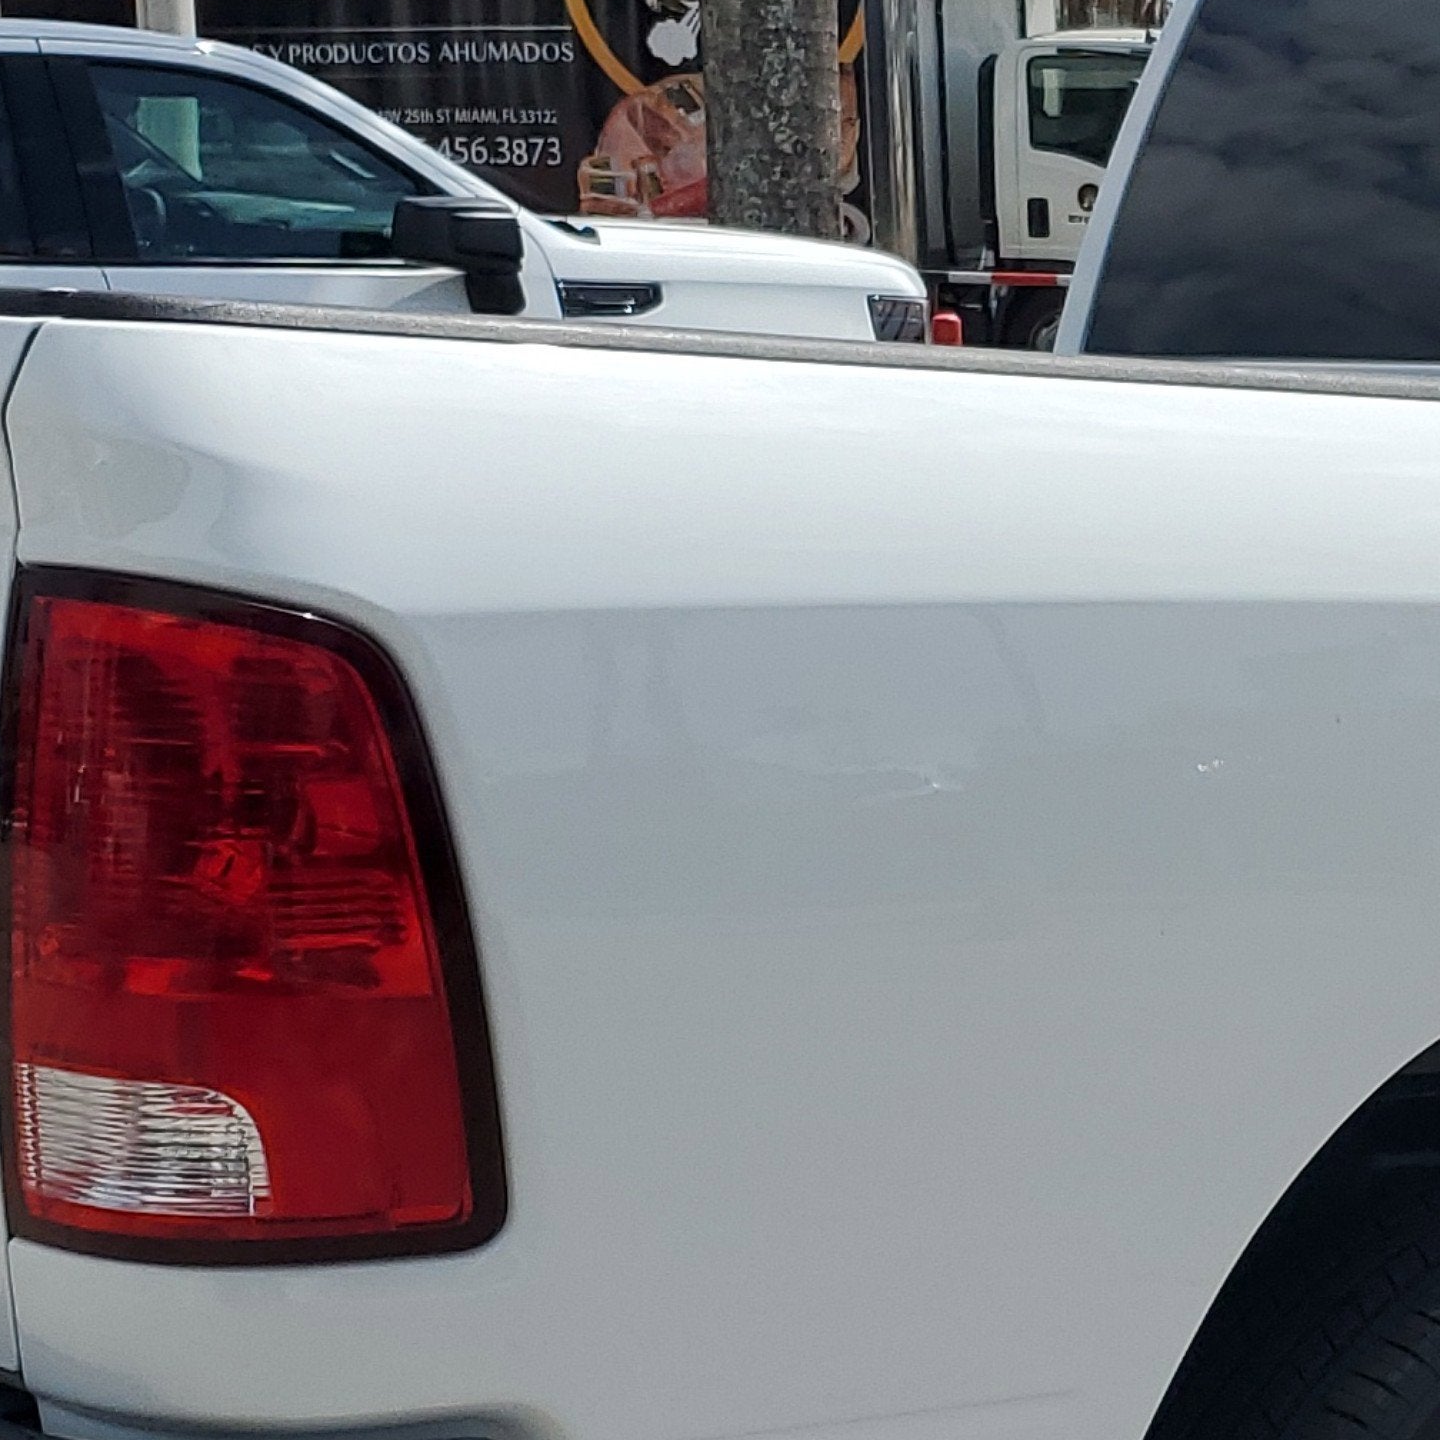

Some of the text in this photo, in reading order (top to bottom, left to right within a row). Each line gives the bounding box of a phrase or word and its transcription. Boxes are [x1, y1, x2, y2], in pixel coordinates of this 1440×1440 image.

[288, 41, 431, 64] PRODUCTOS
[439, 40, 575, 63] AHUMADOS
[405, 107, 434, 124] 25th
[436, 107, 450, 124] ST
[455, 107, 500, 126] MIAMI,
[502, 107, 517, 124] FL
[416, 135, 562, 167] 456.3873
